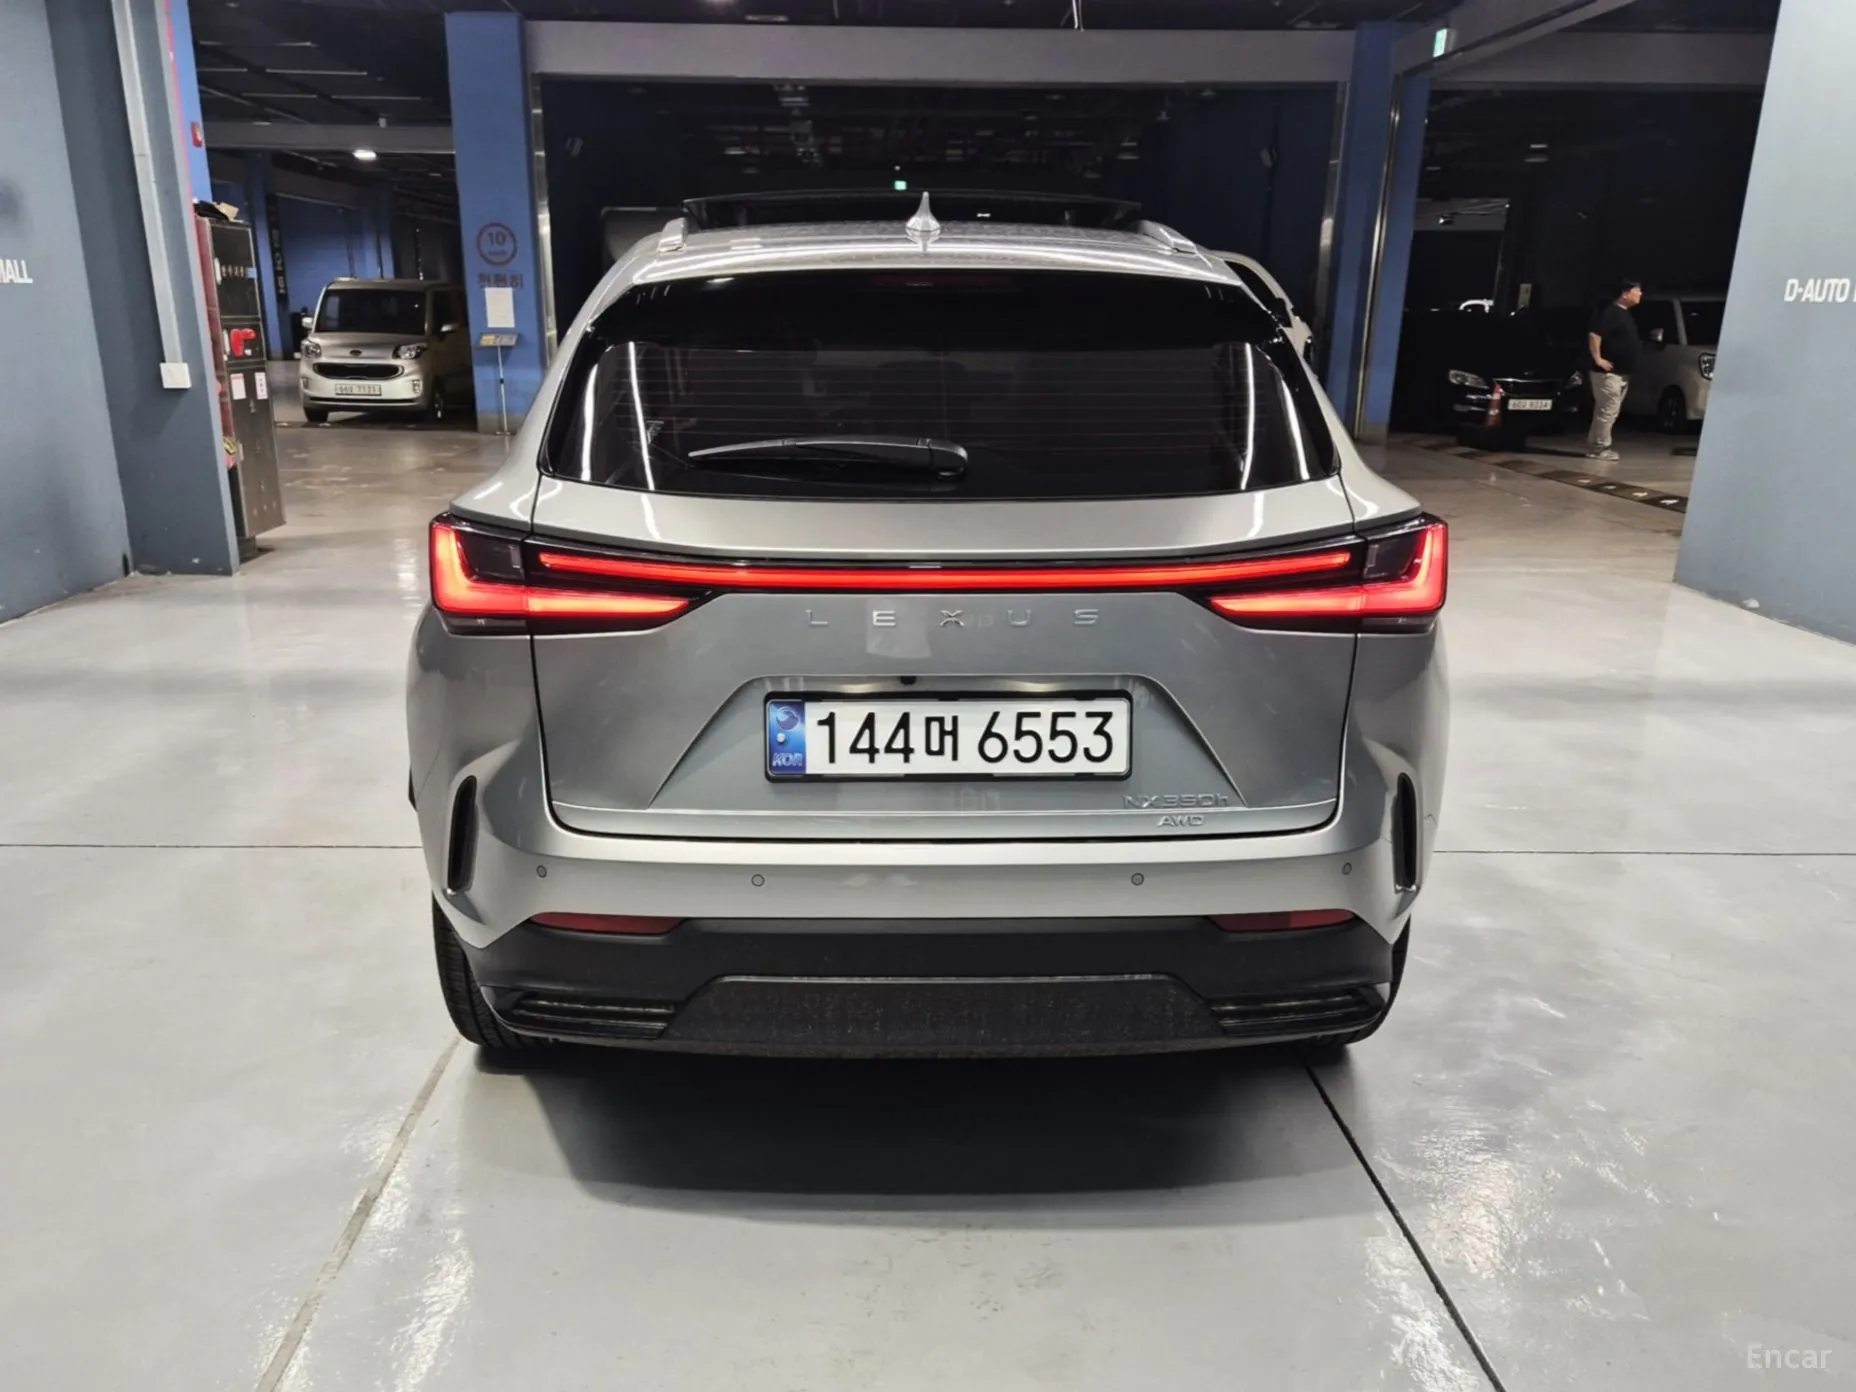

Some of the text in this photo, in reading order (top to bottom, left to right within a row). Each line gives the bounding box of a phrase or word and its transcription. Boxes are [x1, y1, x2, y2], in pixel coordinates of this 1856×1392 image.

[488, 231, 506, 246] 10
[1784, 278, 1851, 303] D-AUTO
[807, 608, 1099, 627] LEXUS
[817, 711, 1114, 764] 144머 6553
[1157, 815, 1205, 827] AWD
